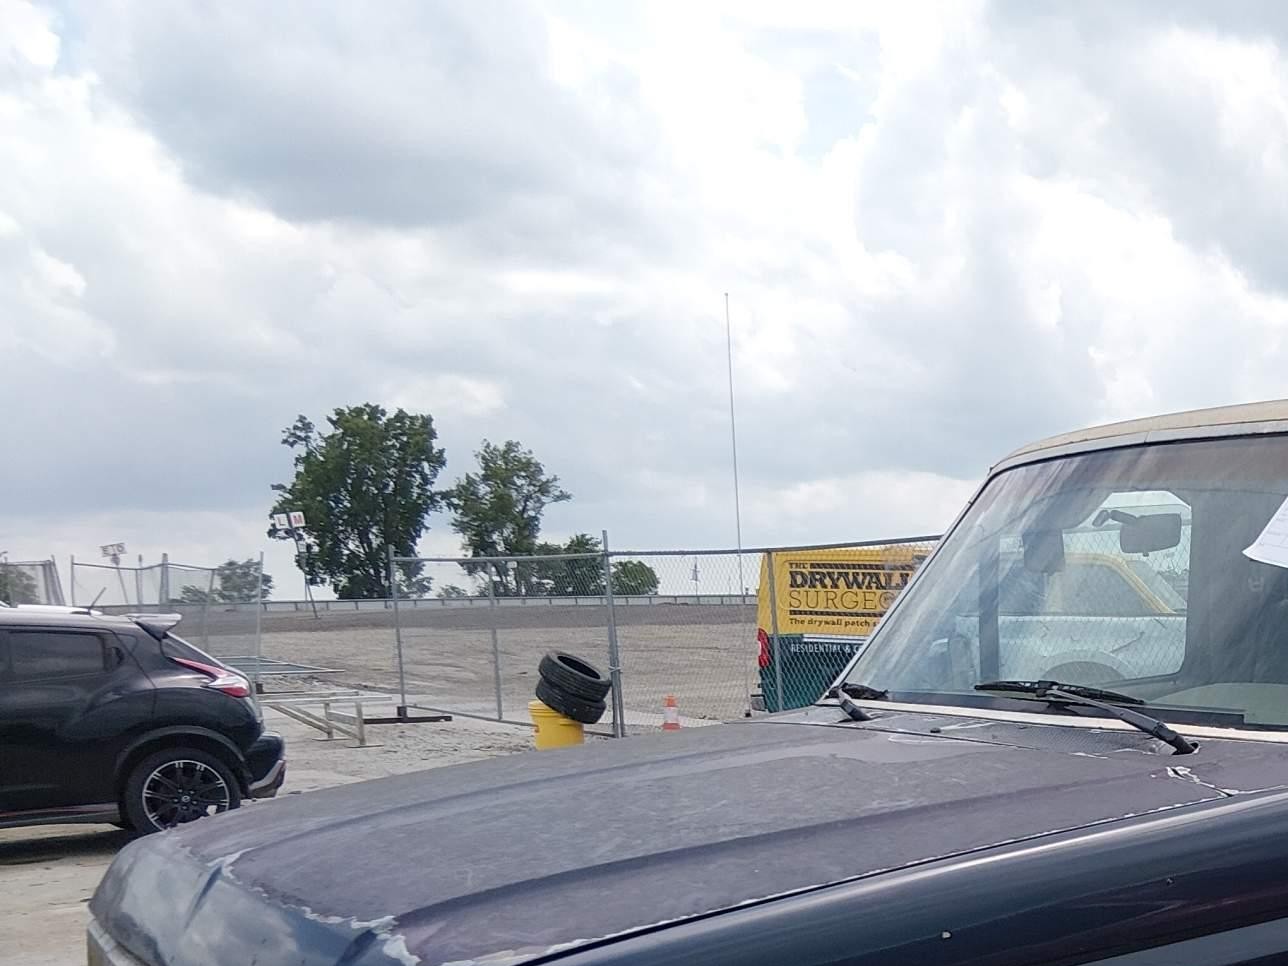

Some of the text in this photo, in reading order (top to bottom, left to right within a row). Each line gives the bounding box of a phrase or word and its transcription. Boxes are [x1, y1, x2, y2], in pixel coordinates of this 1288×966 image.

[807, 618, 842, 627] drywall
[844, 619, 870, 628] patch
[791, 643, 842, 653] RESIDENTIAL
